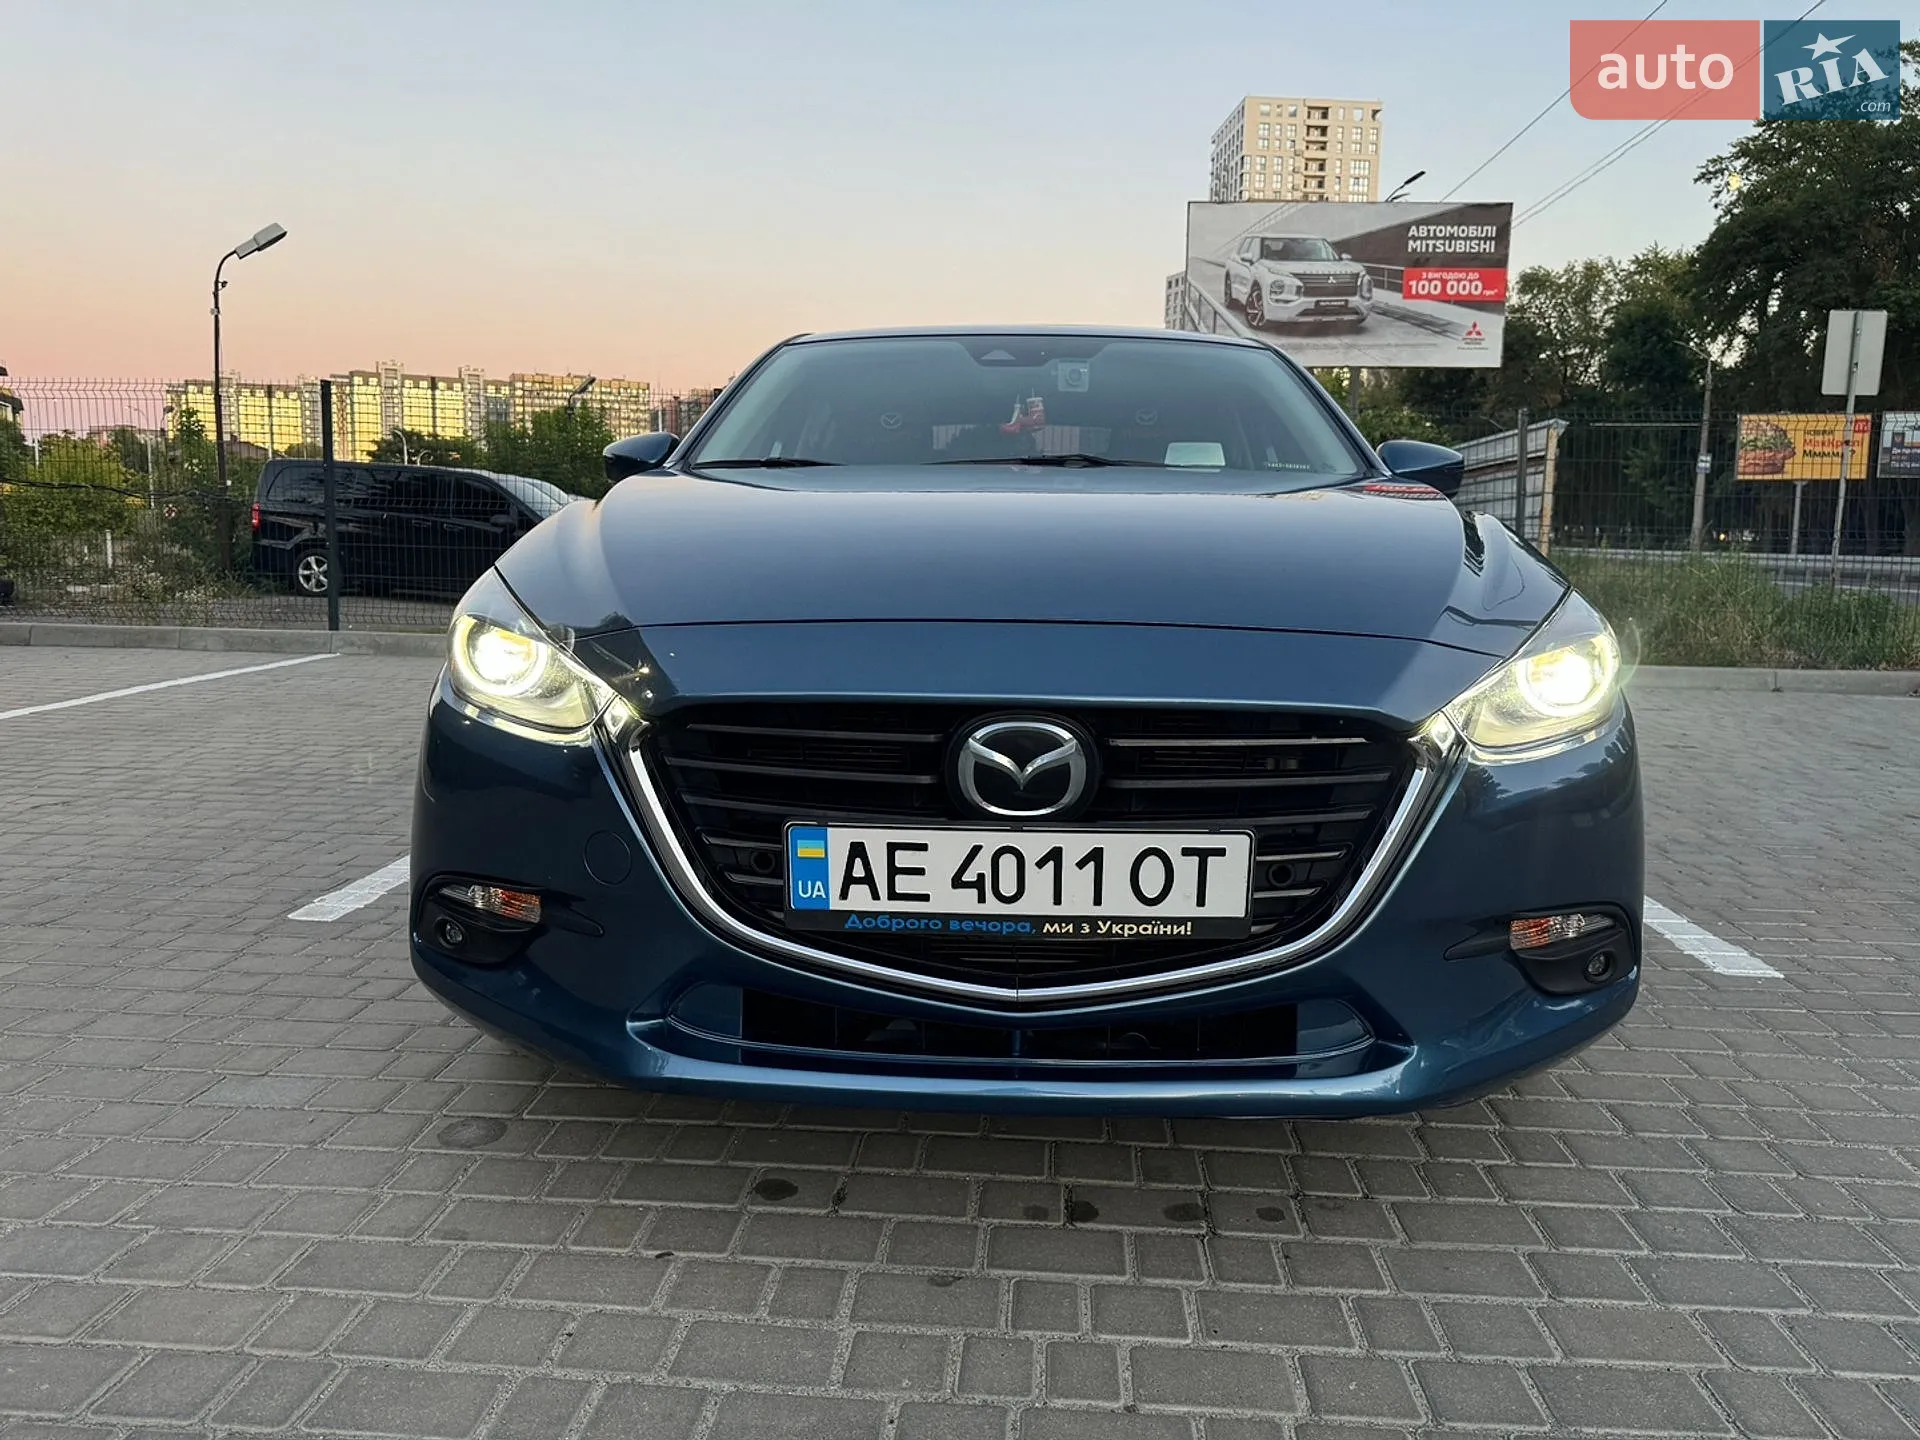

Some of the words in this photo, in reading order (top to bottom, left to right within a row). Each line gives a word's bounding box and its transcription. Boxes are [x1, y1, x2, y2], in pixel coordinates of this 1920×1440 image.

[1407, 225, 1497, 238] АВТОМОБІЛІ
[1407, 240, 1496, 253] MITSUBISHI
[1408, 280, 1442, 295] 100
[1446, 280, 1483, 296] 000
[838, 841, 931, 902] AE
[950, 844, 1104, 906] 4011
[1129, 846, 1227, 908] OT
[798, 880, 827, 899] UA
[844, 914, 942, 931] Доброго
[949, 919, 1036, 935] вечора,
[1042, 921, 1074, 934] ми
[1080, 923, 1091, 934] з
[1097, 920, 1192, 937] України!
